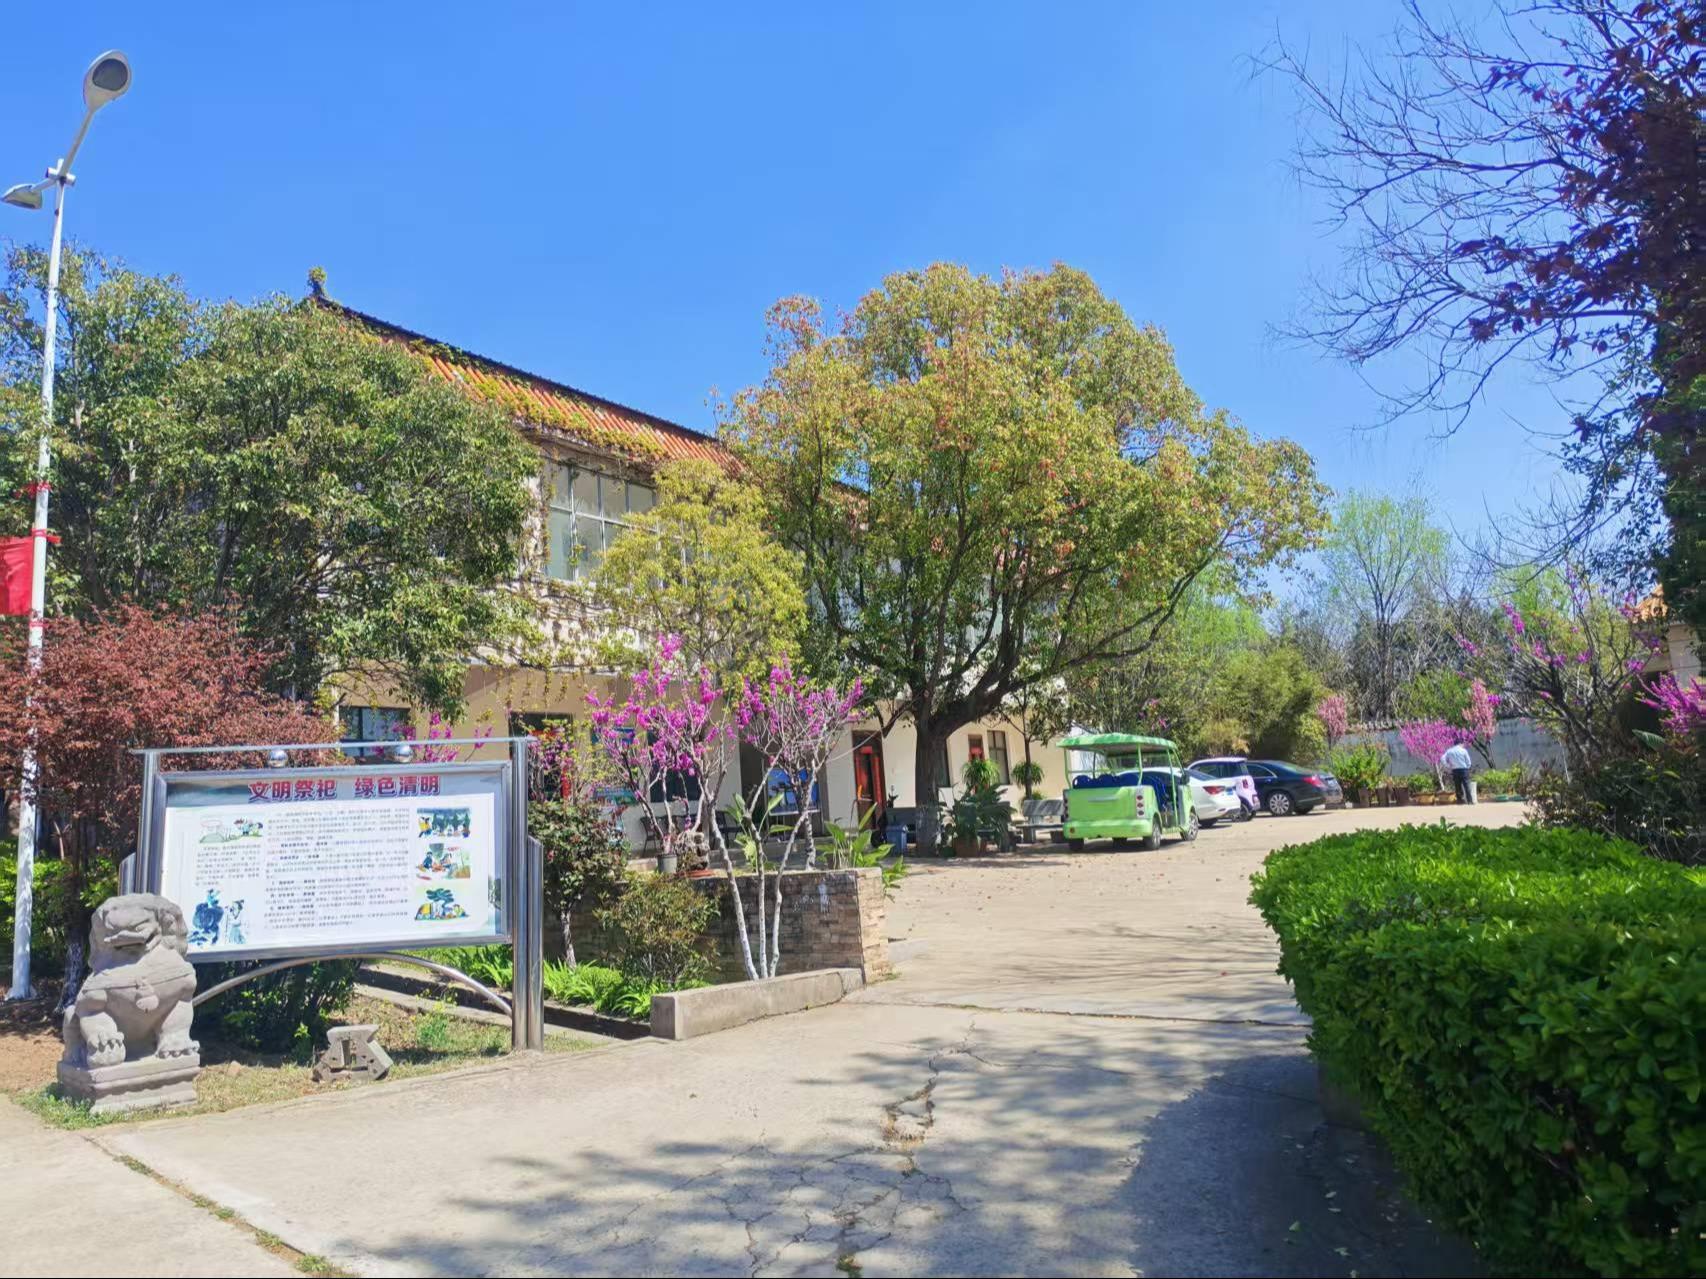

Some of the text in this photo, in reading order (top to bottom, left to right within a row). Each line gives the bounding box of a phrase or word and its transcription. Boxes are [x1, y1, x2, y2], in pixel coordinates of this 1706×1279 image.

[249, 775, 441, 802] 文明祭祀 绿色清明
